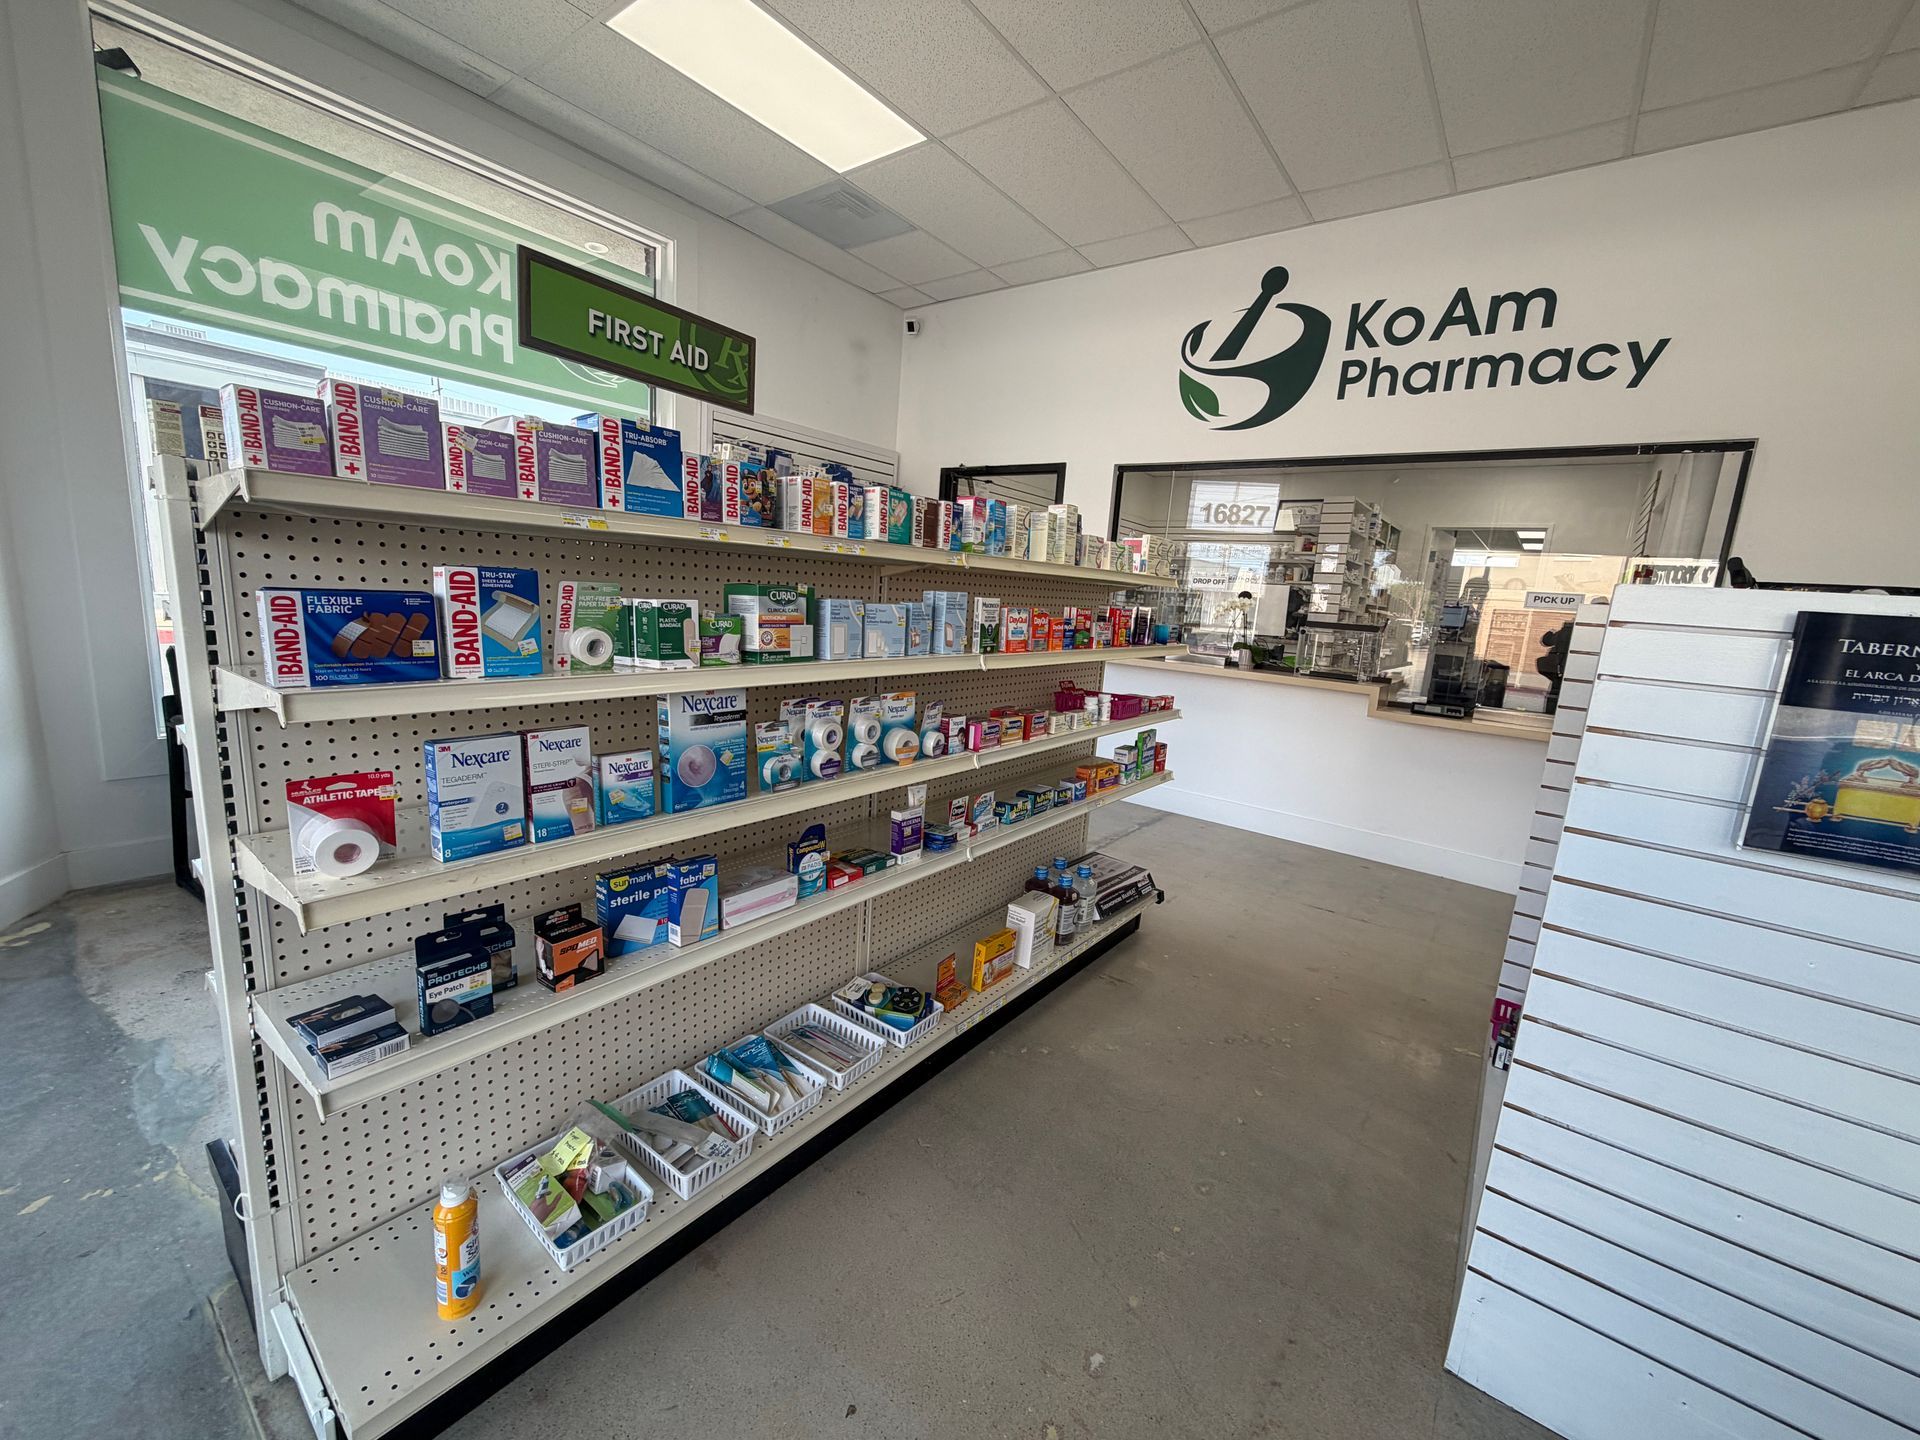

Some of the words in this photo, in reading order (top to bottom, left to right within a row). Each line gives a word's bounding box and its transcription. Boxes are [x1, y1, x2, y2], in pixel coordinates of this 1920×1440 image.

[588, 307, 663, 356] FIRST
[669, 340, 709, 371] AID
[1337, 337, 1672, 400] Pharmacy
[263, 398, 321, 414] CUSHION-CARE
[363, 395, 429, 414] CUSHION-CARE
[237, 388, 263, 451] BAND-AID
[334, 382, 361, 457] BAND-AID
[538, 431, 588, 445] CUSHION-CARE
[624, 431, 667, 446] TRU-ABSORB
[602, 418, 622, 489] BAND-AID
[686, 457, 699, 514] BAND-AID
[726, 464, 739, 519] BAND-AID
[801, 478, 813, 527] BAND-AID
[838, 484, 848, 531] BAND-AID
[880, 489, 888, 535] BAND-AID
[1200, 502, 1270, 526] 16827
[943, 503, 952, 544] BAND-AID
[481, 571, 516, 579] TRU-STAY
[306, 595, 363, 605] FLEXIBLE
[769, 591, 797, 600] CURAD
[1533, 595, 1558, 605] PICK
[1560, 597, 1575, 605] UP
[307, 605, 353, 614] FABRIC
[559, 584, 574, 629] BAND-AID
[449, 570, 481, 665] BAND-AID
[710, 620, 733, 628] CURAD
[1009, 616, 1027, 625] DayQuil
[270, 595, 304, 675] BAND-AID
[1845, 669, 1860, 678] EL
[1863, 671, 1904, 682] ARCA
[681, 695, 737, 716] Nexcare
[887, 705, 908, 714] Nexcare
[713, 714, 740, 722] Tegaderm
[539, 738, 582, 752] Nexcare
[757, 736, 777, 745] Nexcare
[450, 750, 510, 768] Nexcare
[532, 759, 570, 770] STERI-STRIP
[608, 760, 649, 775] Nexcare
[442, 773, 484, 785] TEGADERM
[739, 781, 745, 790] 4
[302, 791, 354, 805] ATHLETIC
[354, 788, 380, 798] TAPE
[441, 798, 468, 806] waterproof
[536, 828, 547, 838] 18
[444, 849, 452, 858] 8
[680, 872, 706, 885] fabric
[610, 891, 650, 908] sterile
[427, 961, 488, 987] PROTECHS
[428, 990, 443, 1000] Eye
[443, 983, 465, 995] Patch
